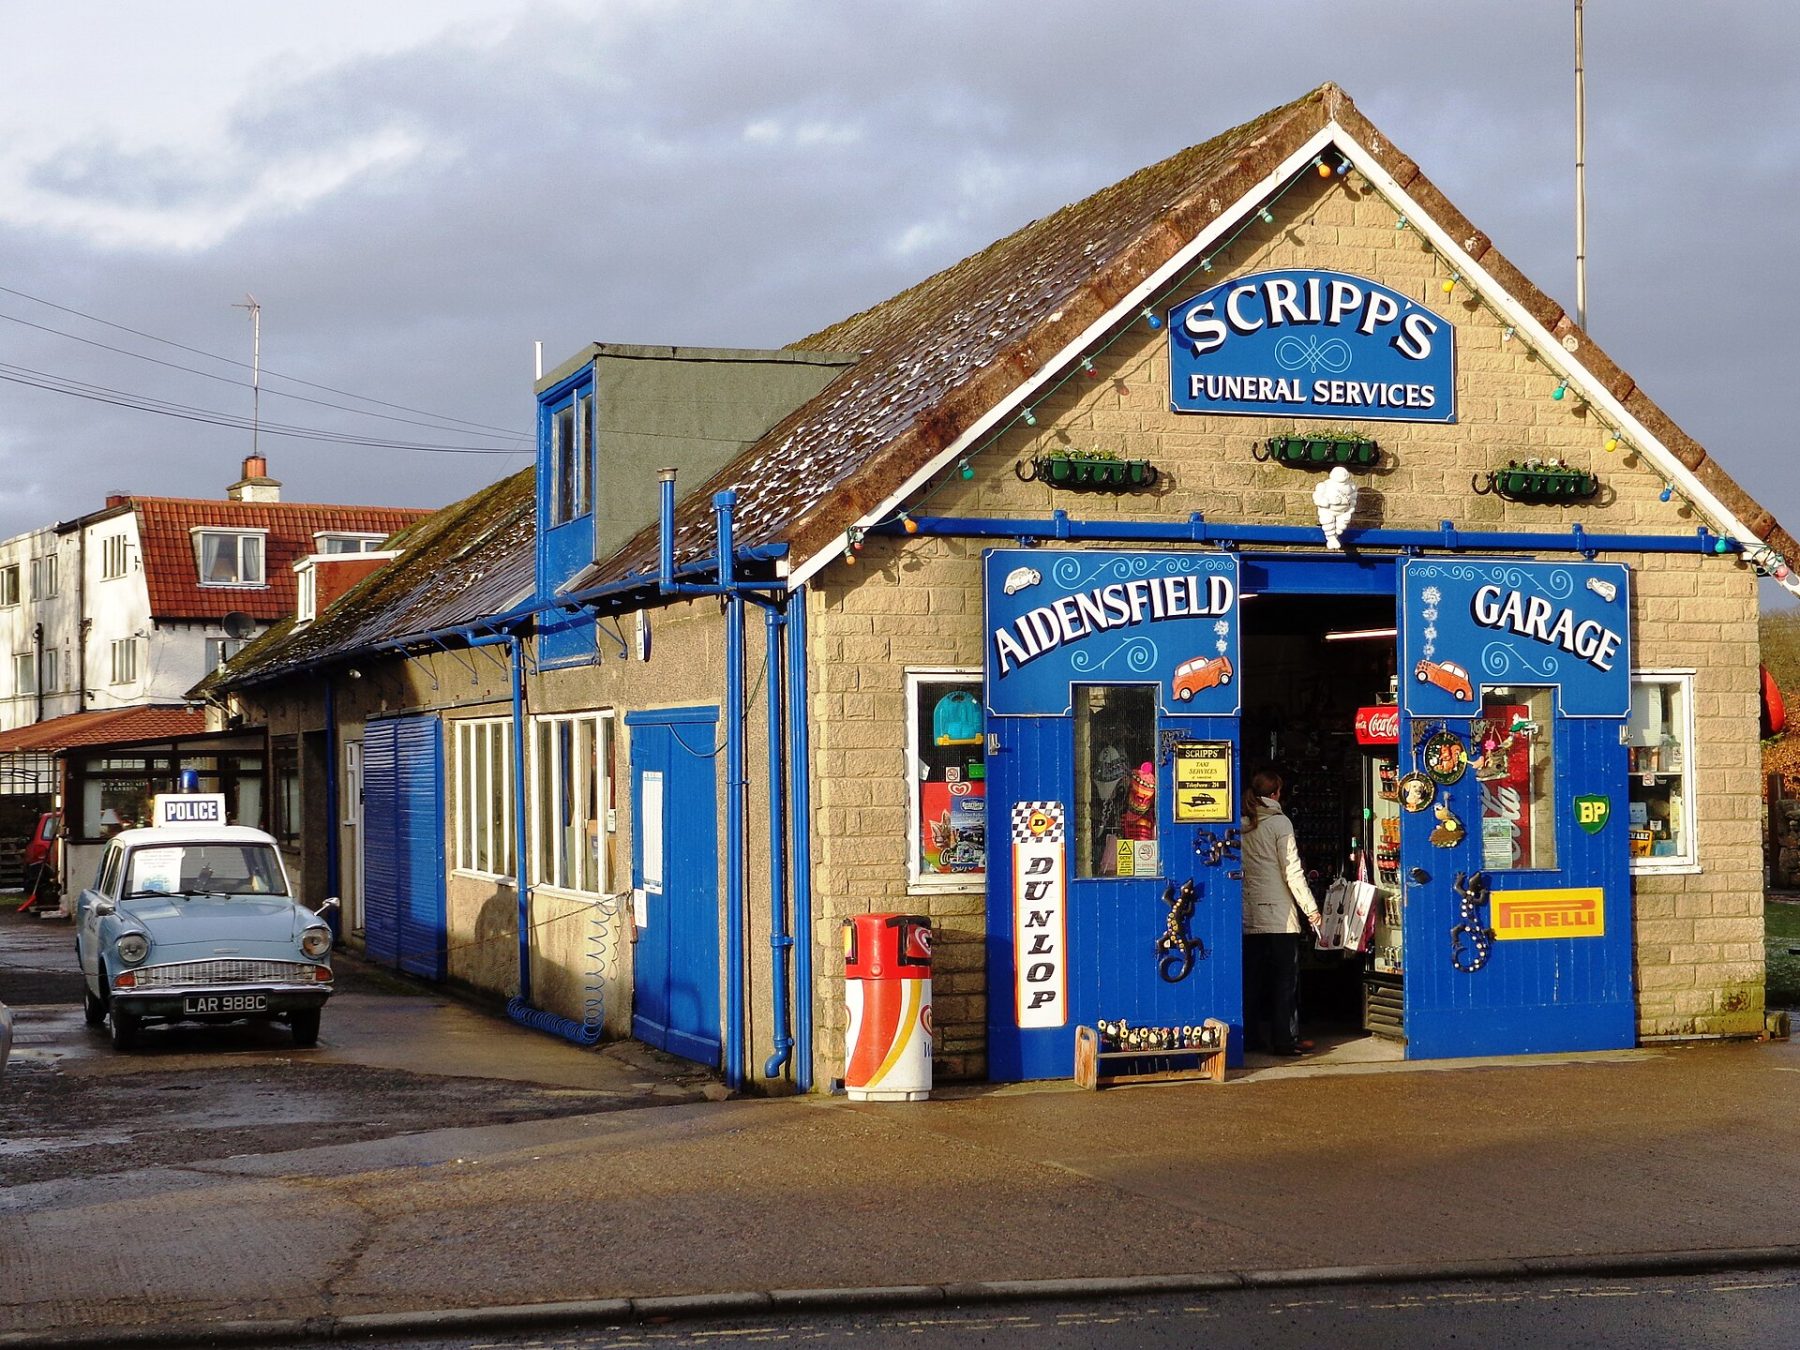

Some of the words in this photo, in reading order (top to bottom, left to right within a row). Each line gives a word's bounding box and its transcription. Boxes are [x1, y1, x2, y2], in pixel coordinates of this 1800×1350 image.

[1184, 278, 1438, 361] SCRIPP'S
[1190, 374, 1307, 402] FUNERAL
[1313, 380, 1436, 408] SERVICES
[994, 575, 1234, 676] AIDENSFIELD
[1473, 584, 1622, 671] GARAGE
[166, 801, 217, 820] POLICE
[1578, 801, 1606, 823] BP
[1498, 899, 1596, 929] PIRELLI
[1024, 856, 1056, 1009] DUNLOP
[185, 998, 219, 1012] LAR
[222, 996, 266, 1011] 988C
